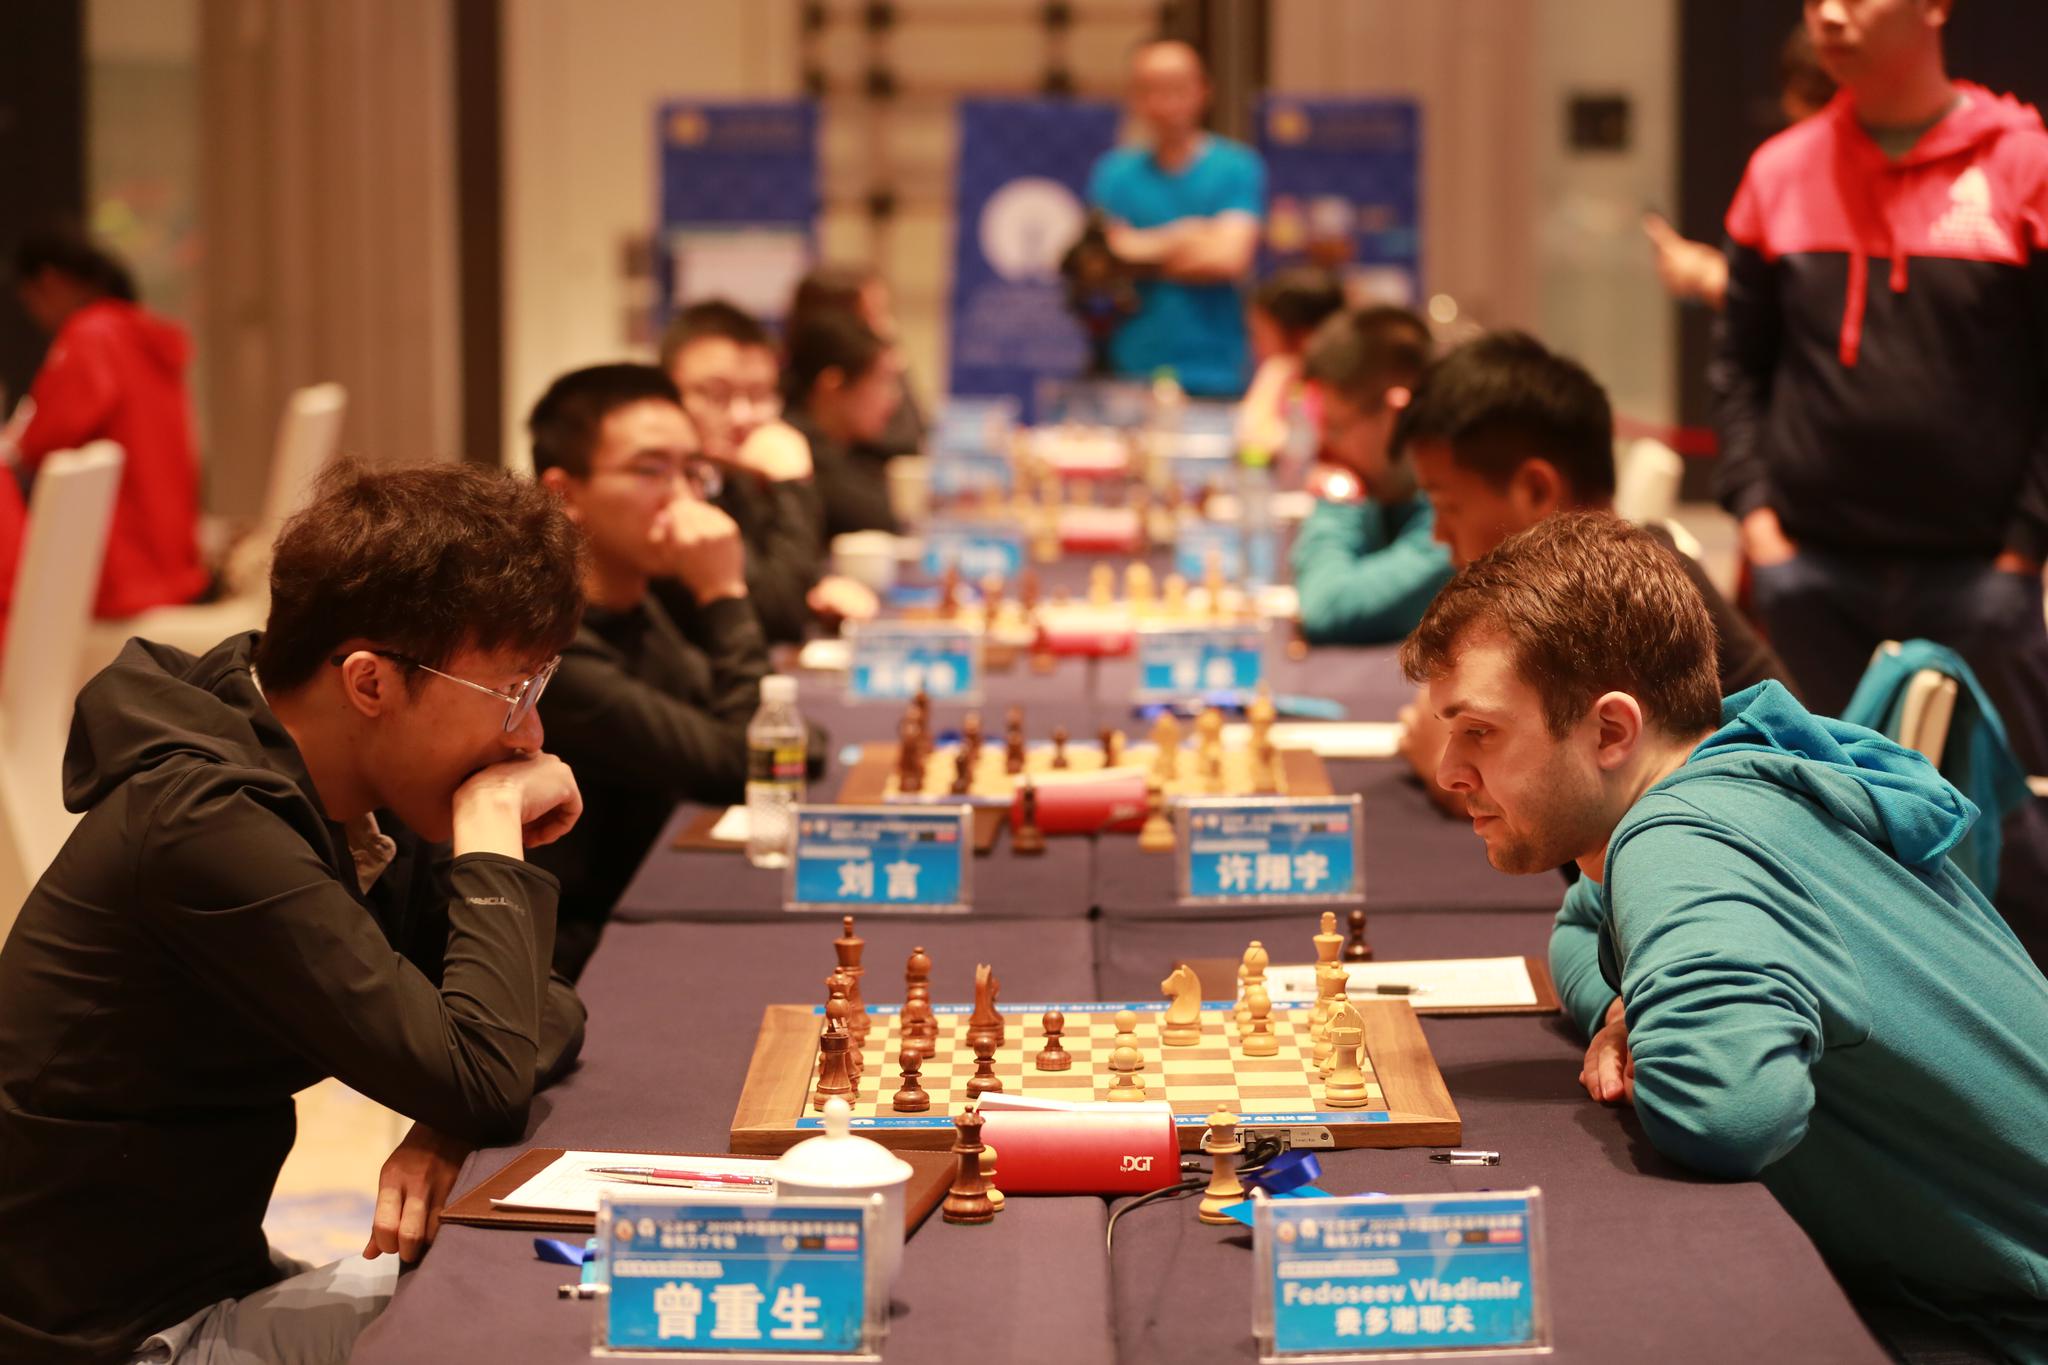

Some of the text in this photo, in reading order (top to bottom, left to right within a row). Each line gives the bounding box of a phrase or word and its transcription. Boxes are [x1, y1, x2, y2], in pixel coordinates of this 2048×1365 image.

[1123, 1155, 1154, 1172] DGT
[1282, 1275, 1523, 1306] Fedoseev Vladimir
[653, 1281, 824, 1341] 曾重生
